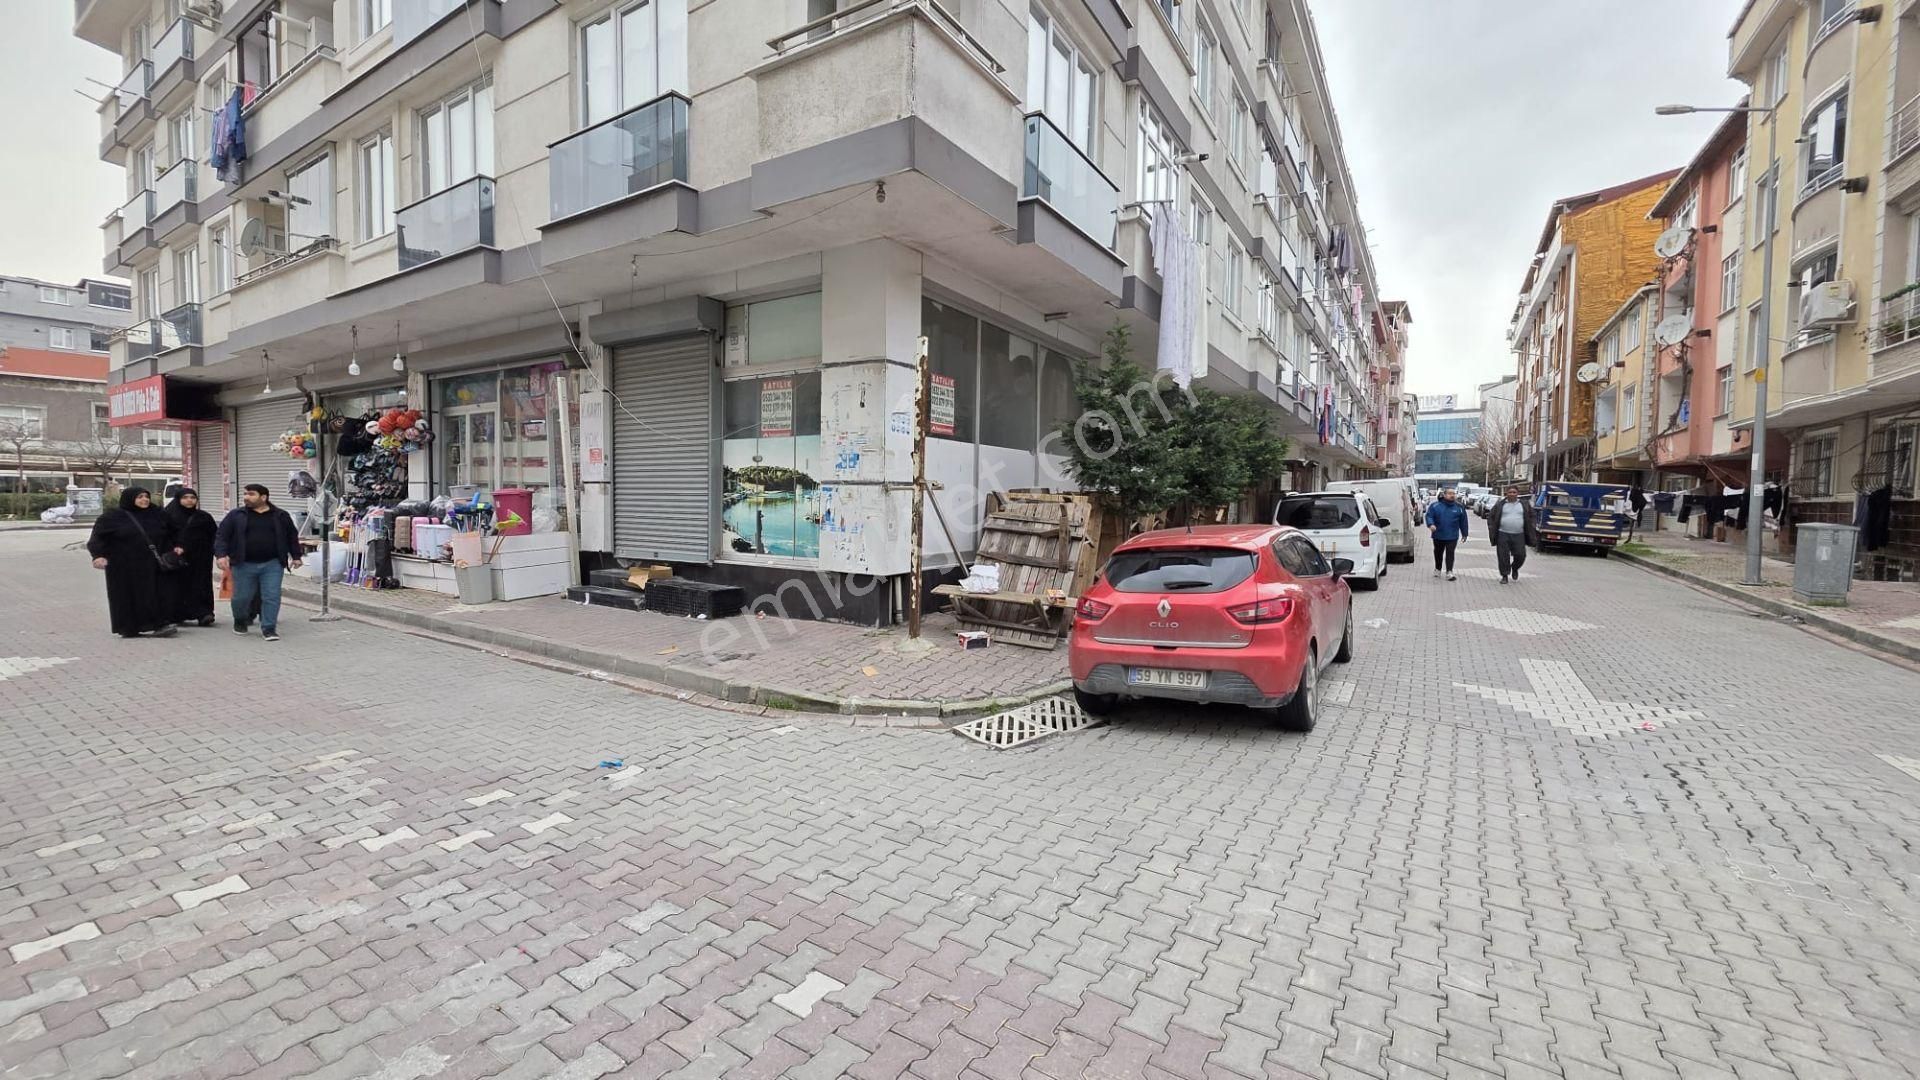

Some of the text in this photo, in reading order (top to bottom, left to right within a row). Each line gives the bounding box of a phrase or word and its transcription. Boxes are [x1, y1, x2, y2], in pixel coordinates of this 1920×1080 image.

[932, 374, 954, 386] SATILIK
[763, 381, 791, 390] SATILIK
[1446, 395, 1454, 404] 2
[1136, 669, 1201, 686] 59 YN 997
